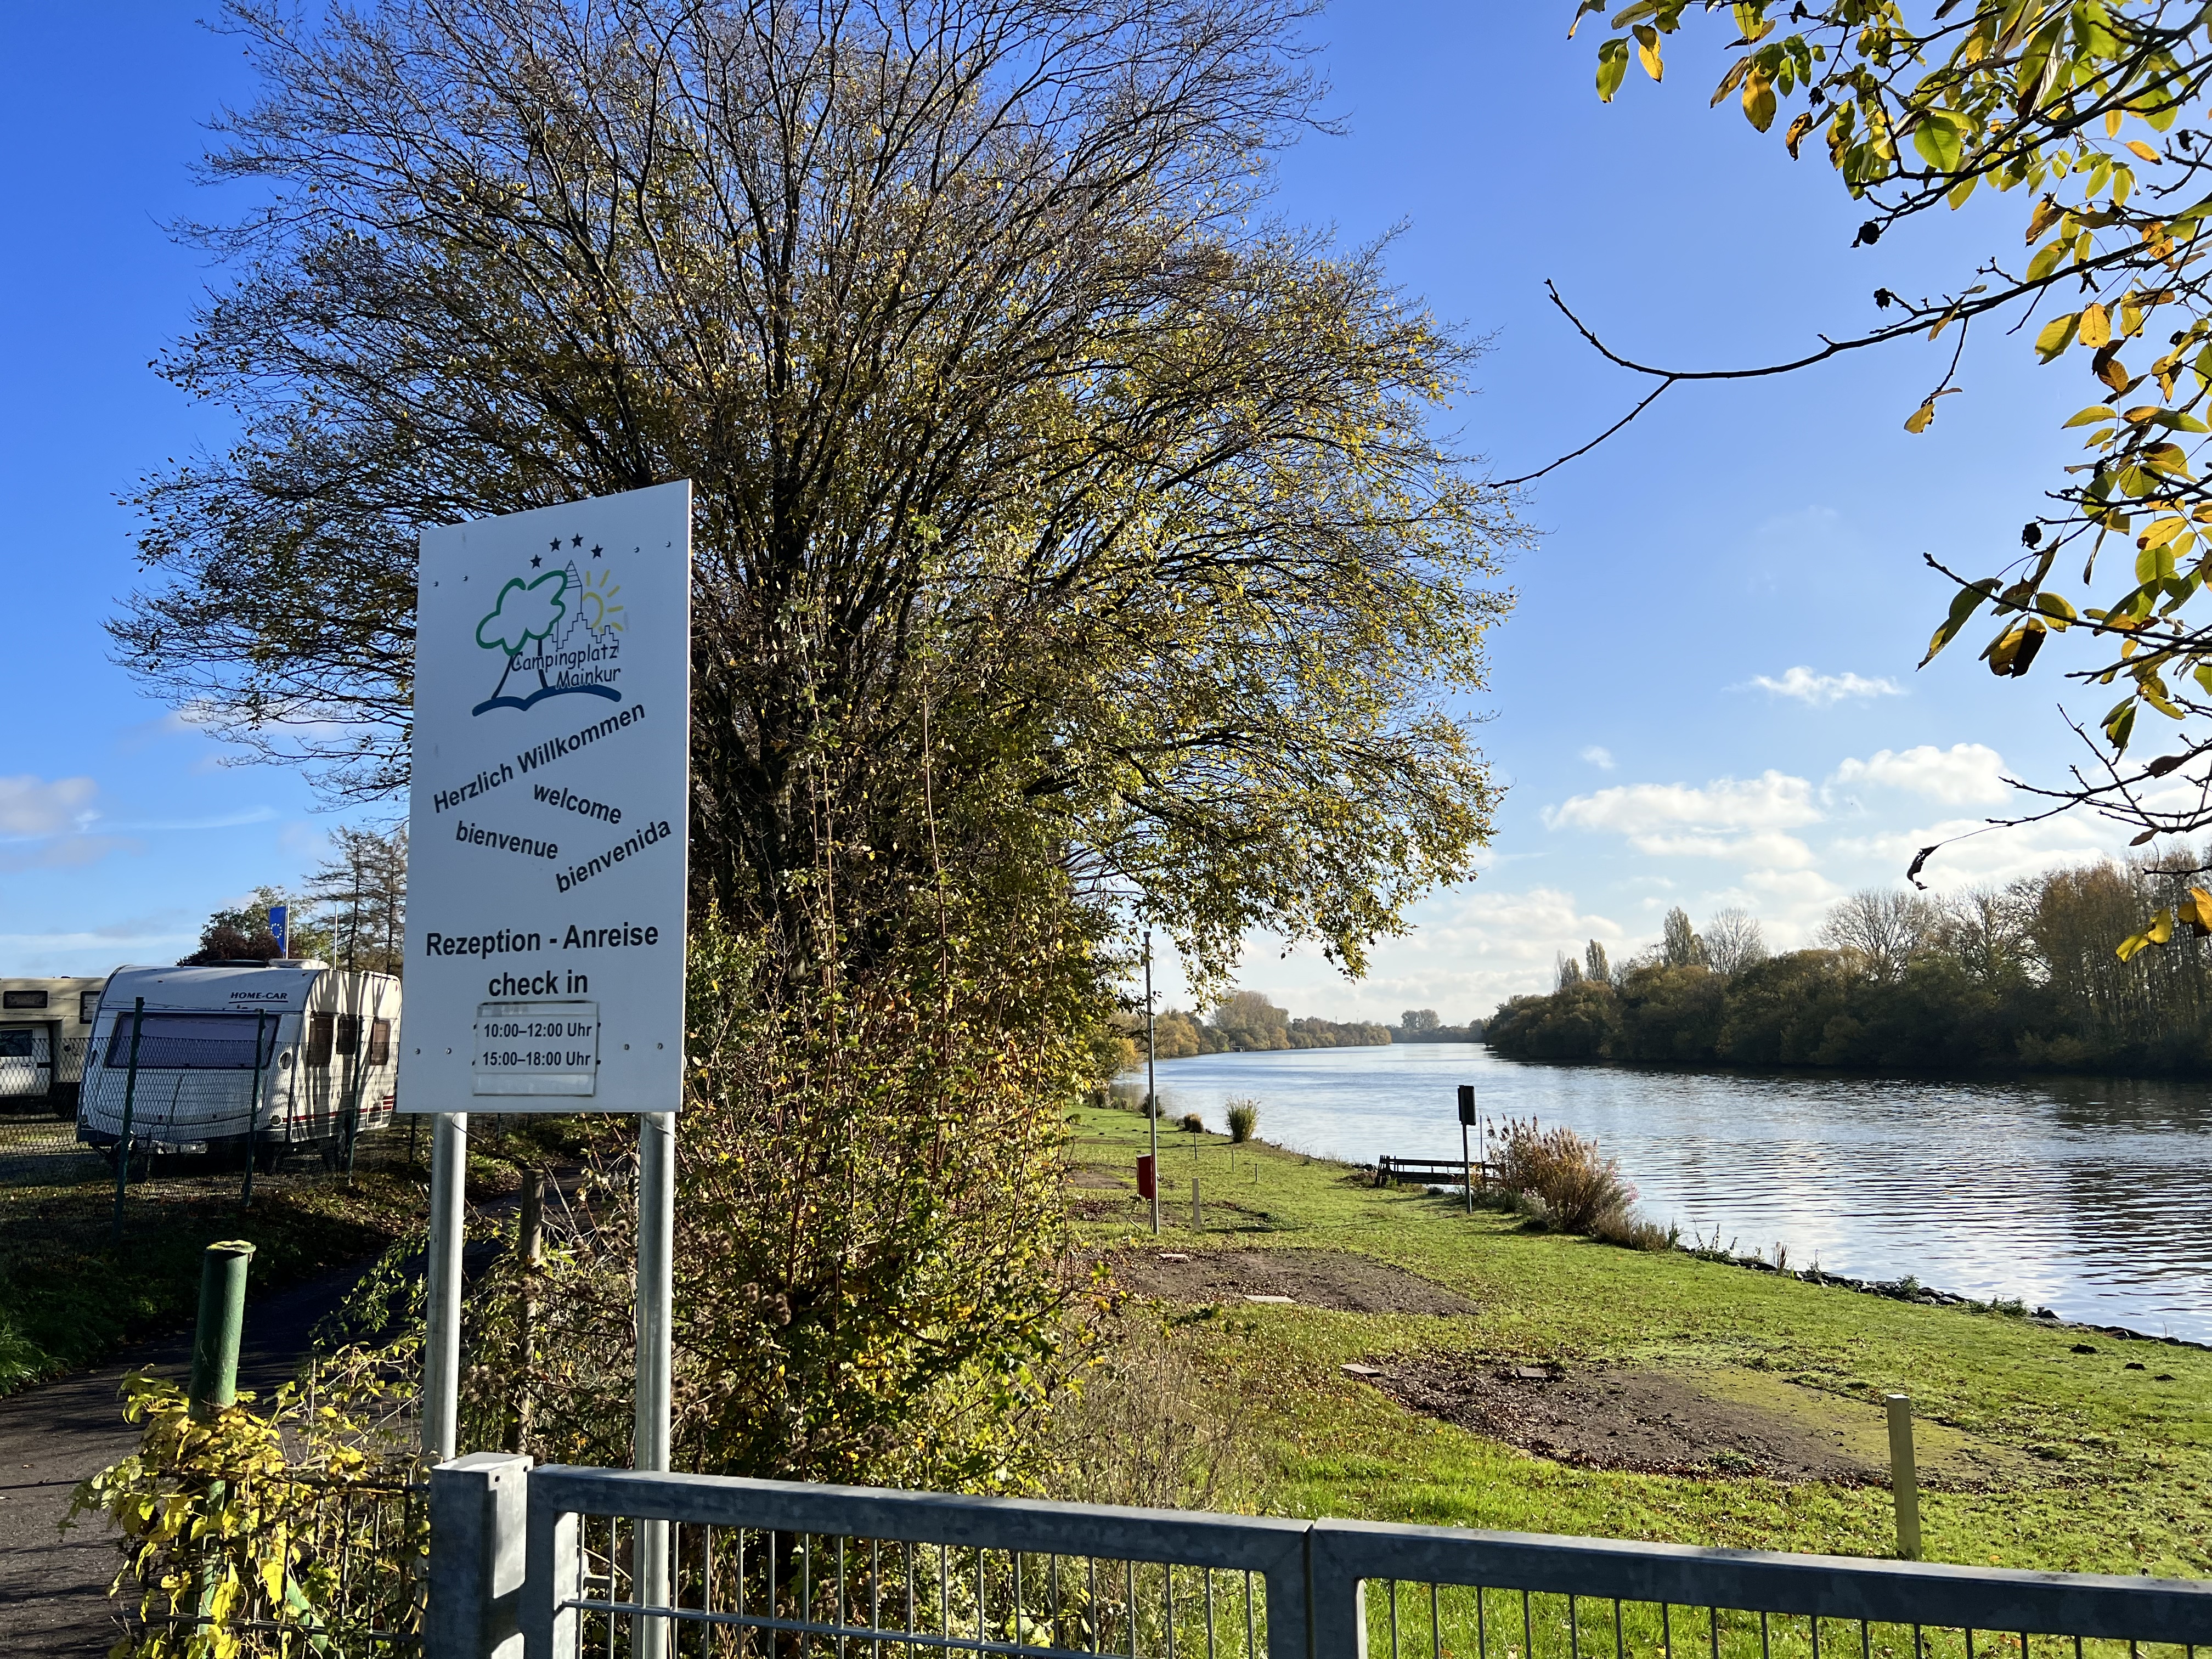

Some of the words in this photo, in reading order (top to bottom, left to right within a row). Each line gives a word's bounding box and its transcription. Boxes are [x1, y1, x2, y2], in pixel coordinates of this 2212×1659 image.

[511, 644, 618, 673] Campingplatz
[555, 665, 621, 689] Mainkur
[433, 763, 514, 813] Herzlich
[517, 704, 645, 774] Willkommen
[534, 783, 622, 824] welcome
[456, 820, 558, 859] bienvenue
[555, 820, 672, 893] bienvenida
[426, 929, 540, 959] Rezeption
[563, 922, 659, 949] Anreise
[489, 970, 558, 996] check
[567, 969, 588, 994] in
[567, 1022, 592, 1037] Uhr
[566, 1051, 591, 1066] Uhr
